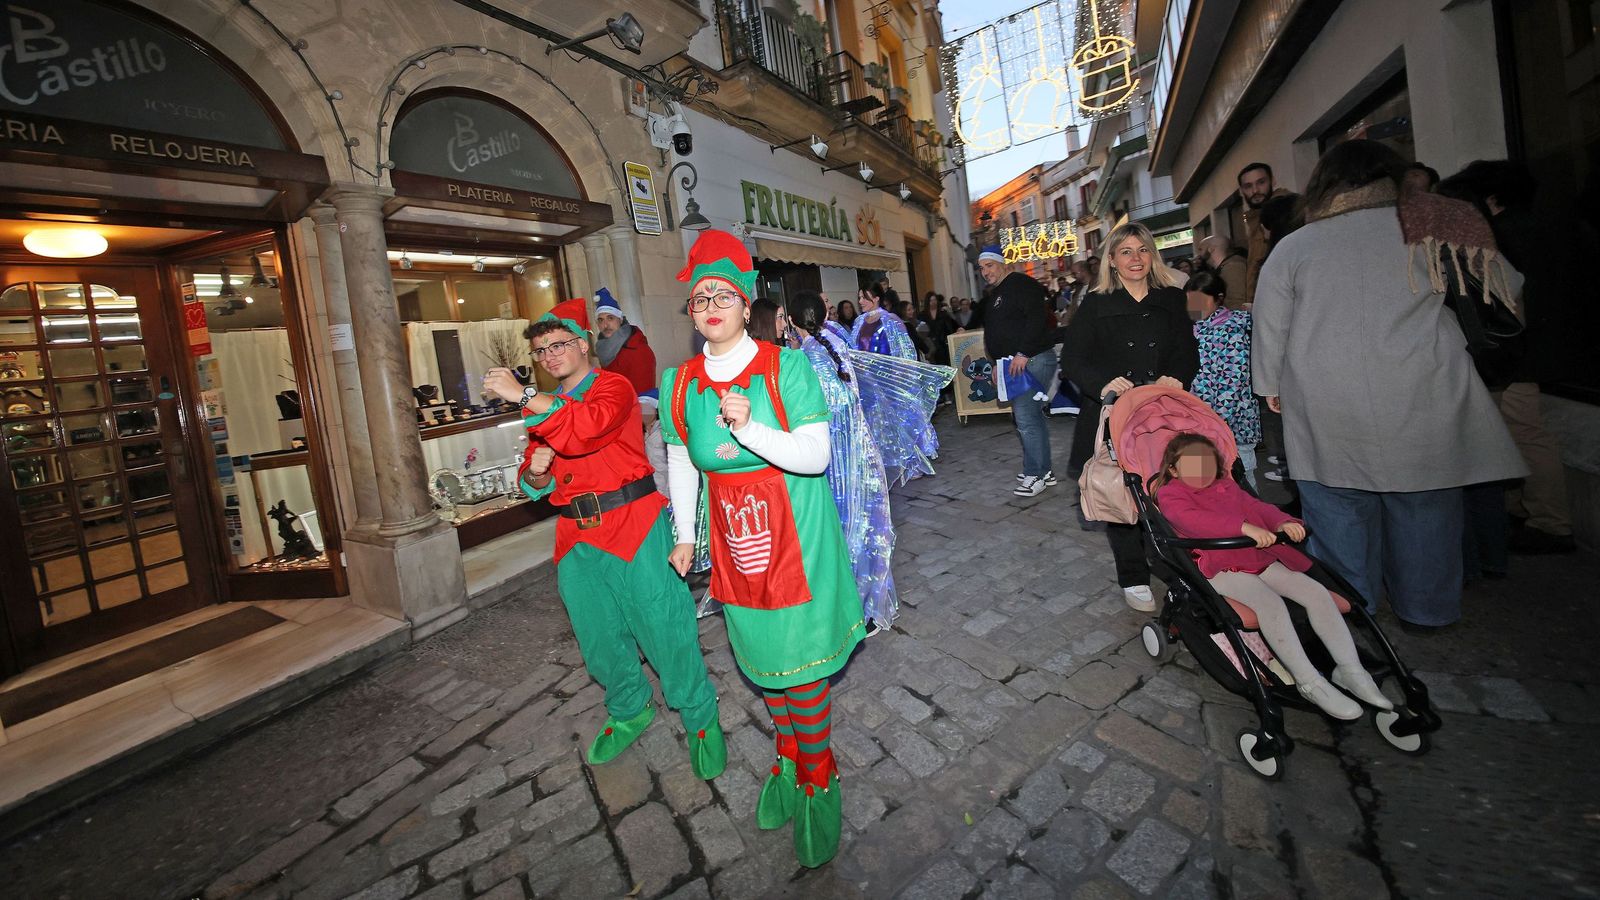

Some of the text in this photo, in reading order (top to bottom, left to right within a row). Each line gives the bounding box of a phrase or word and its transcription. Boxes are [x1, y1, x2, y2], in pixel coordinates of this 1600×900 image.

[0, 37, 167, 106] Castillo
[109, 133, 255, 168] RELOJERIA
[447, 131, 520, 172] Castillo
[447, 183, 580, 214] PLATERIA REGALOS
[741, 180, 885, 248] FRUTERÍA SOL
